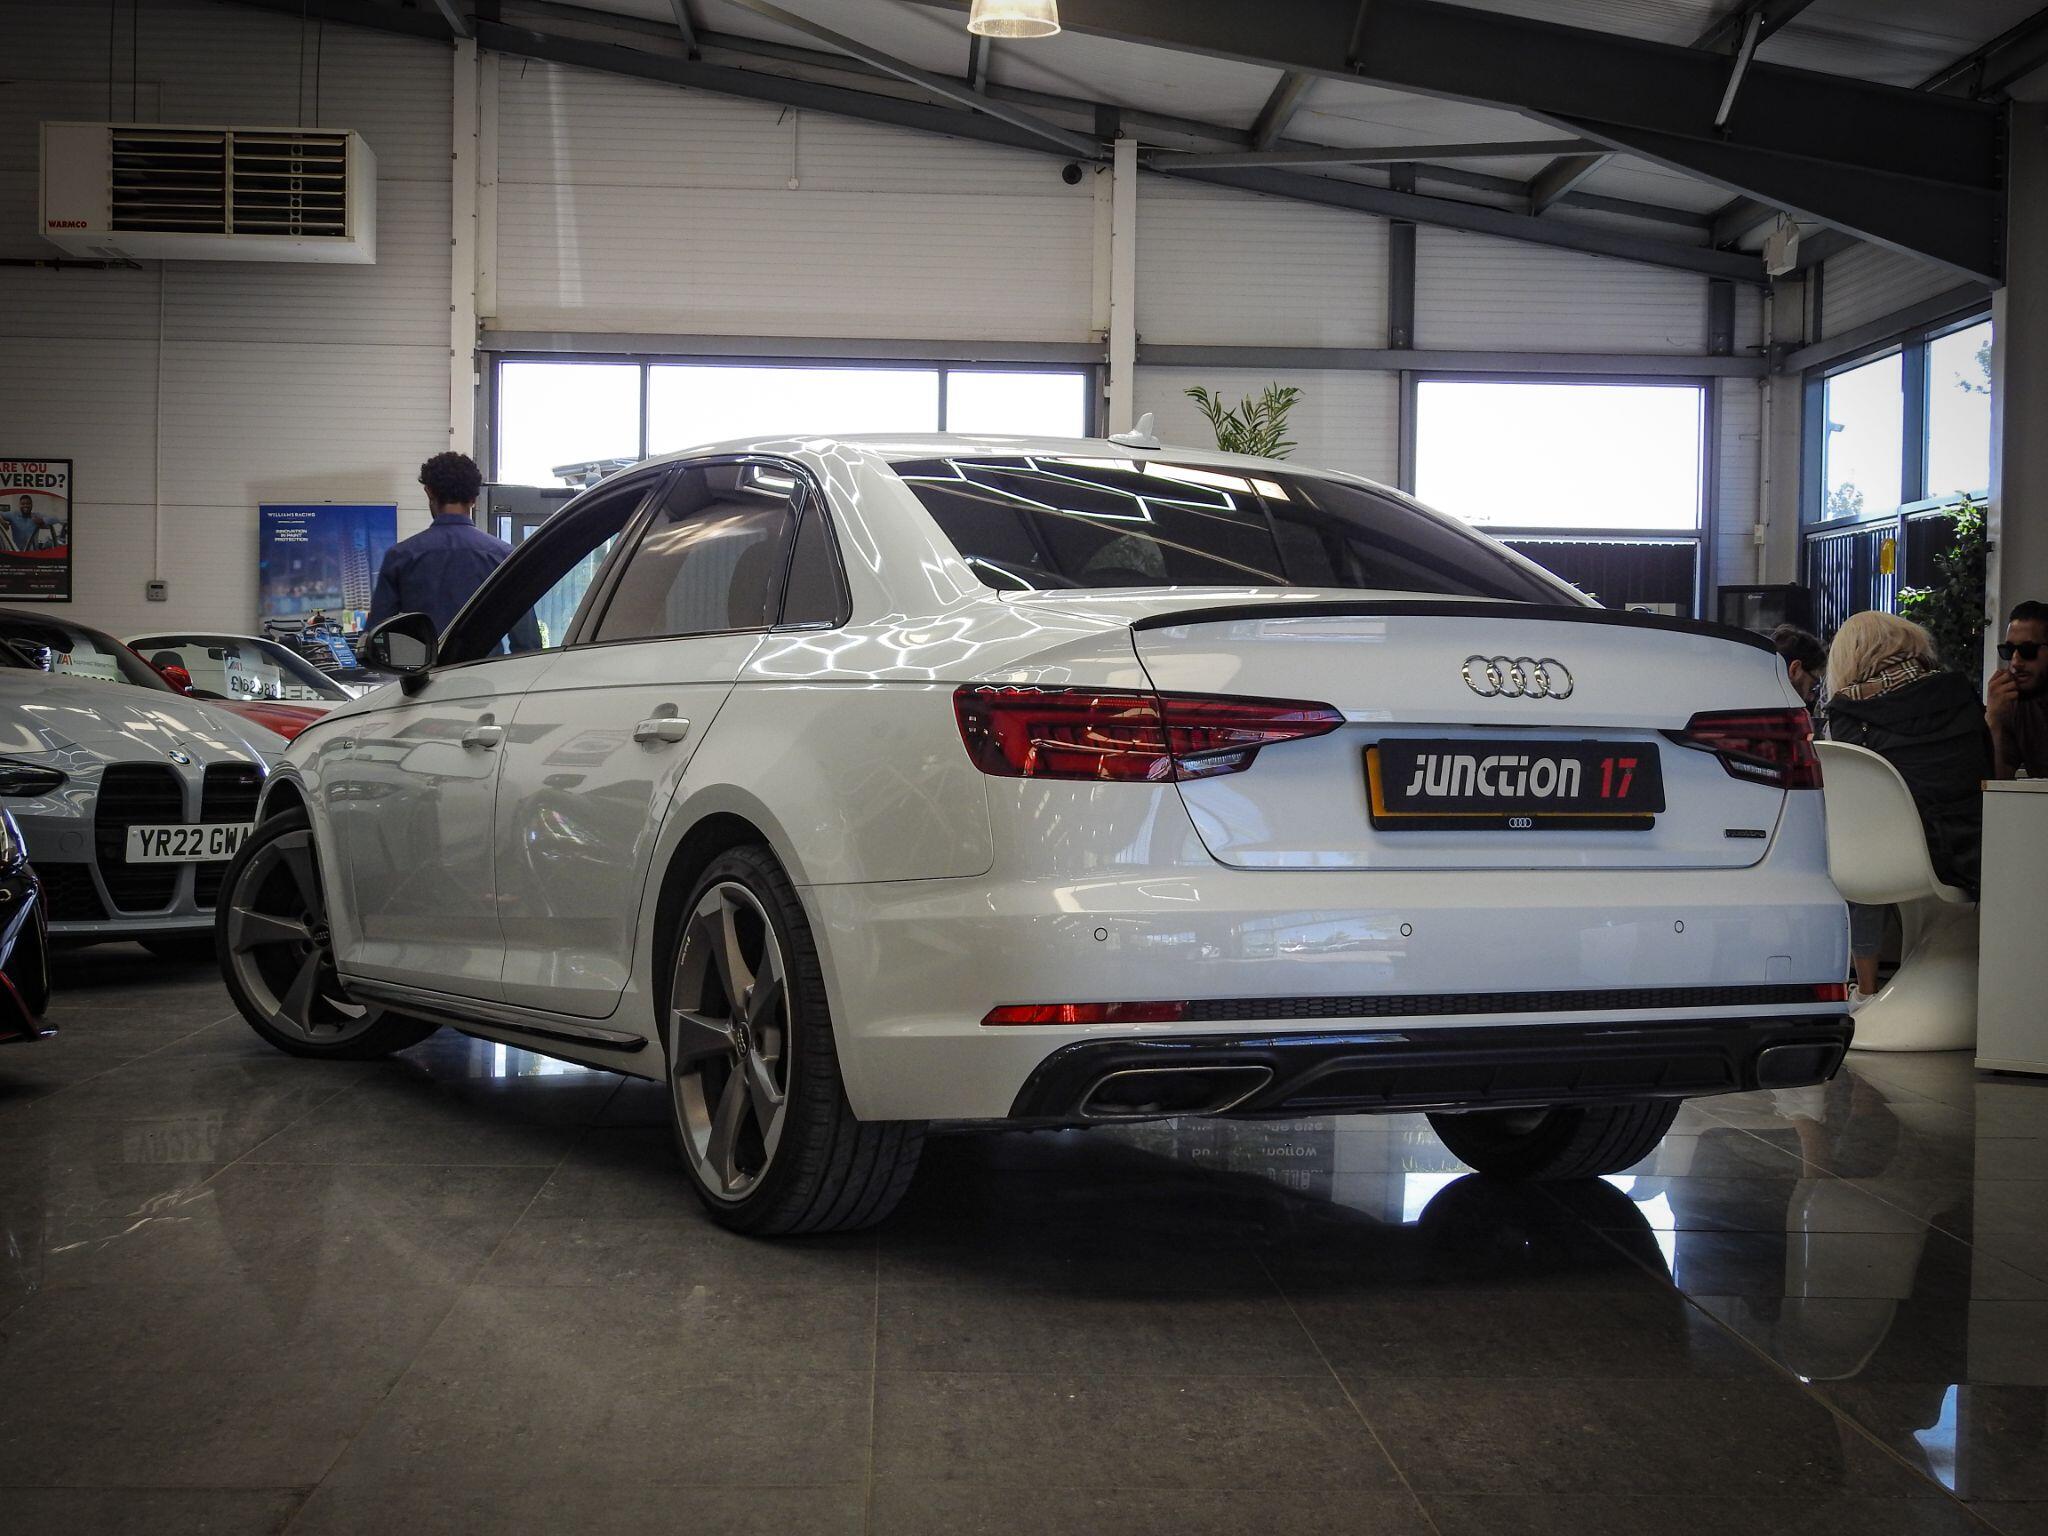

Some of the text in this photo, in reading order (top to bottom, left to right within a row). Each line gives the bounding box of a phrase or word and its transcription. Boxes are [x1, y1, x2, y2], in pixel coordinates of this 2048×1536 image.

[48, 220, 87, 228] WARMCO
[0, 462, 47, 473] RE YOU
[1600, 758, 1638, 798] 17
[140, 829, 204, 857] YR22
